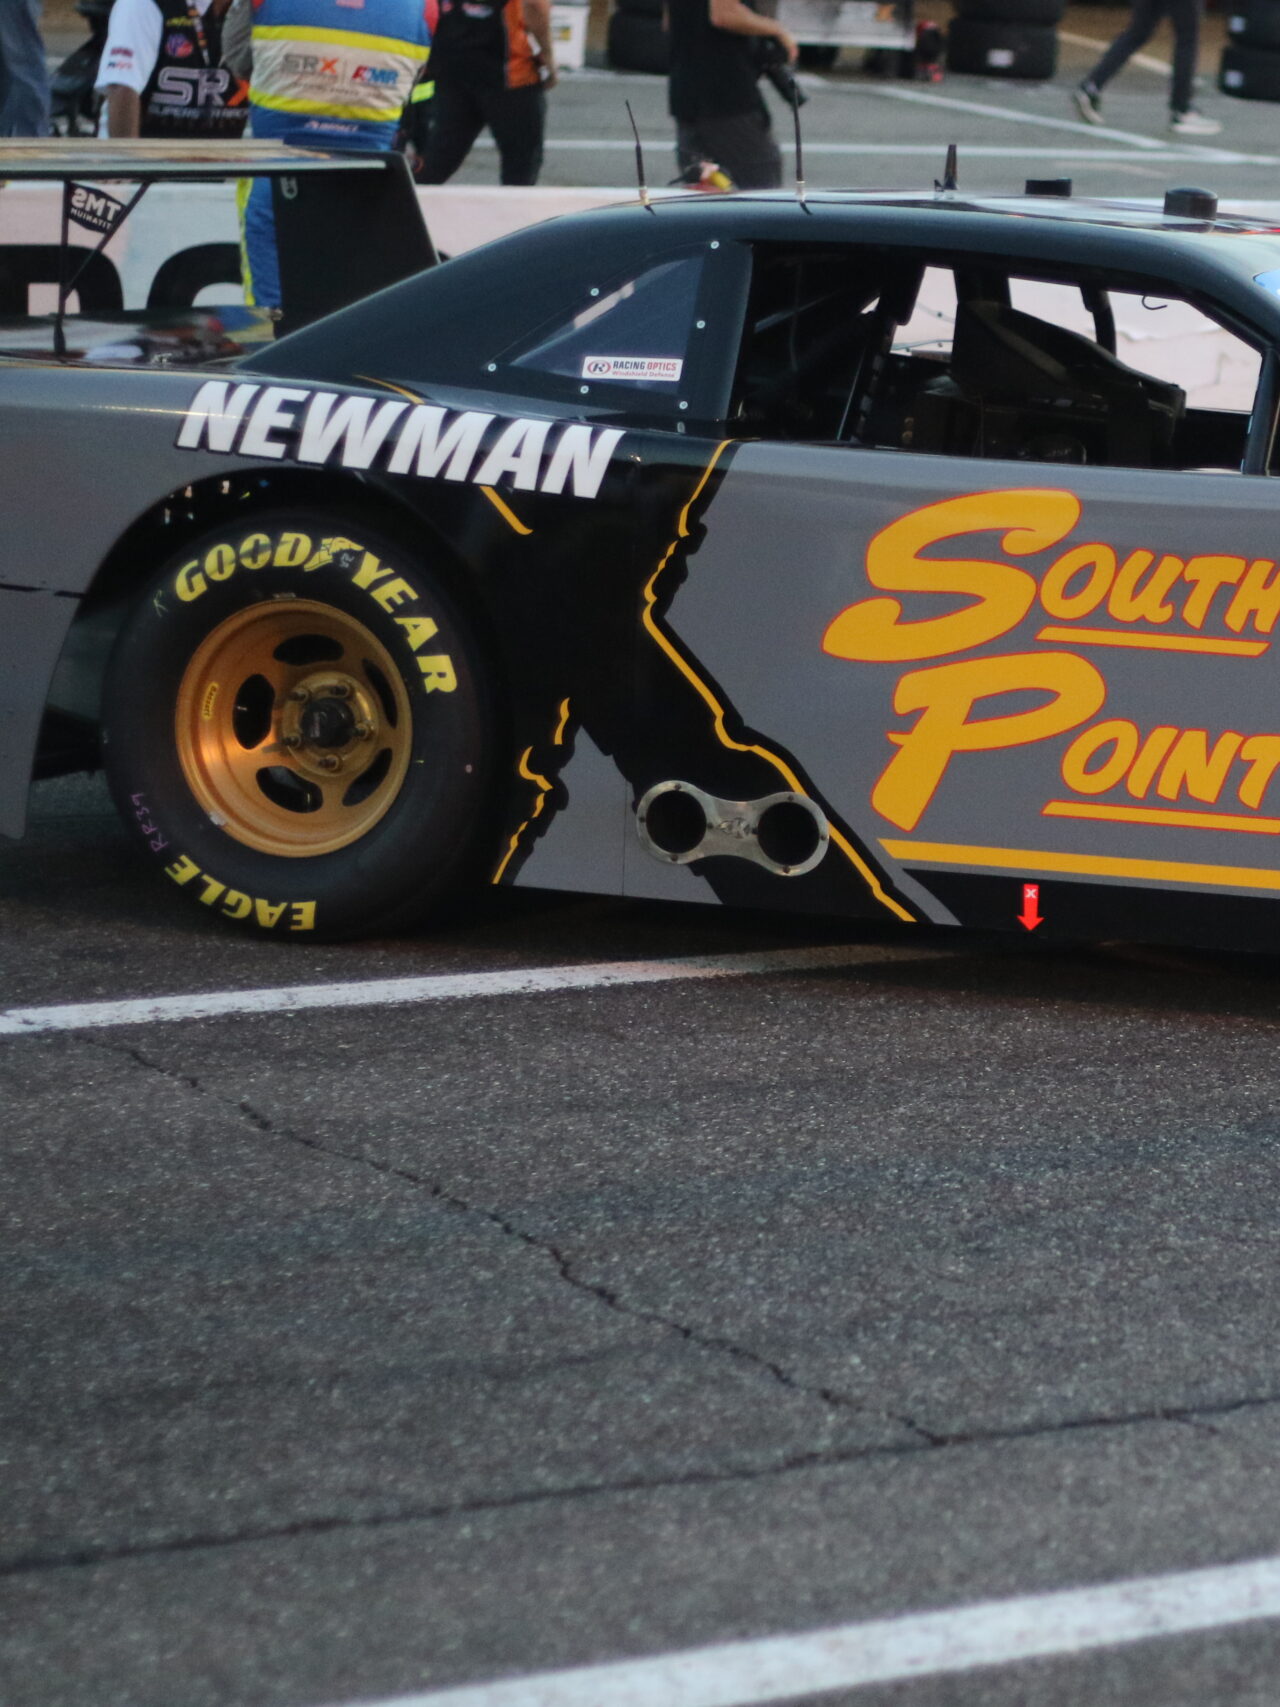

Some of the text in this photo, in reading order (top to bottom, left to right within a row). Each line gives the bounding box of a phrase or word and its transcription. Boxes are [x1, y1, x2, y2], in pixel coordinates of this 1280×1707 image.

[612, 361, 677, 371] RACING OPTICS
[176, 380, 626, 500] NEWMAN
[164, 854, 317, 930] EAGLE
